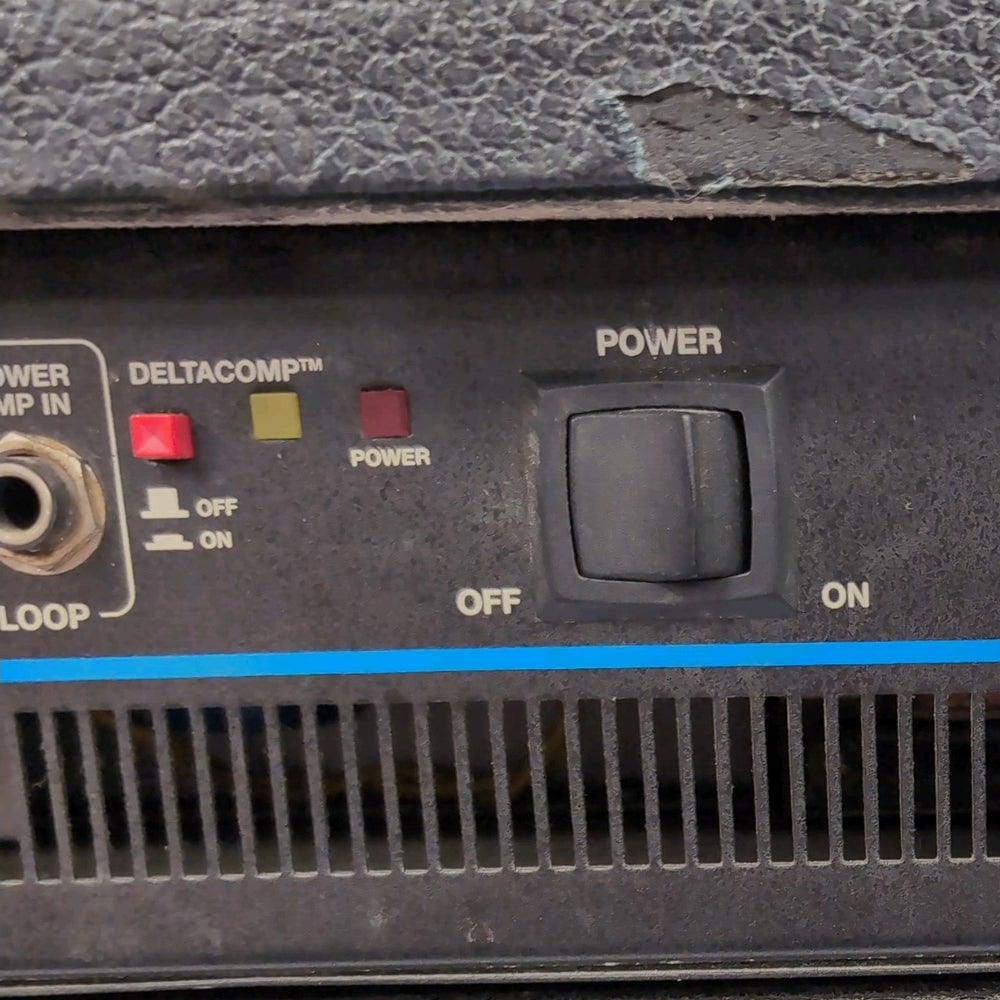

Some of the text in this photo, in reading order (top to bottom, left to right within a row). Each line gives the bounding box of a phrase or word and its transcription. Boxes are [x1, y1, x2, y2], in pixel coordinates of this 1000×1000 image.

[596, 325, 723, 357] POWER
[0, 363, 71, 388] WER
[41, 392, 72, 416] IN
[349, 448, 431, 467] POWER
[194, 498, 239, 517] OFF
[199, 530, 233, 550] ON
[455, 587, 522, 616] OFF
[821, 581, 870, 610] ON
[0, 602, 91, 632] LOOP
